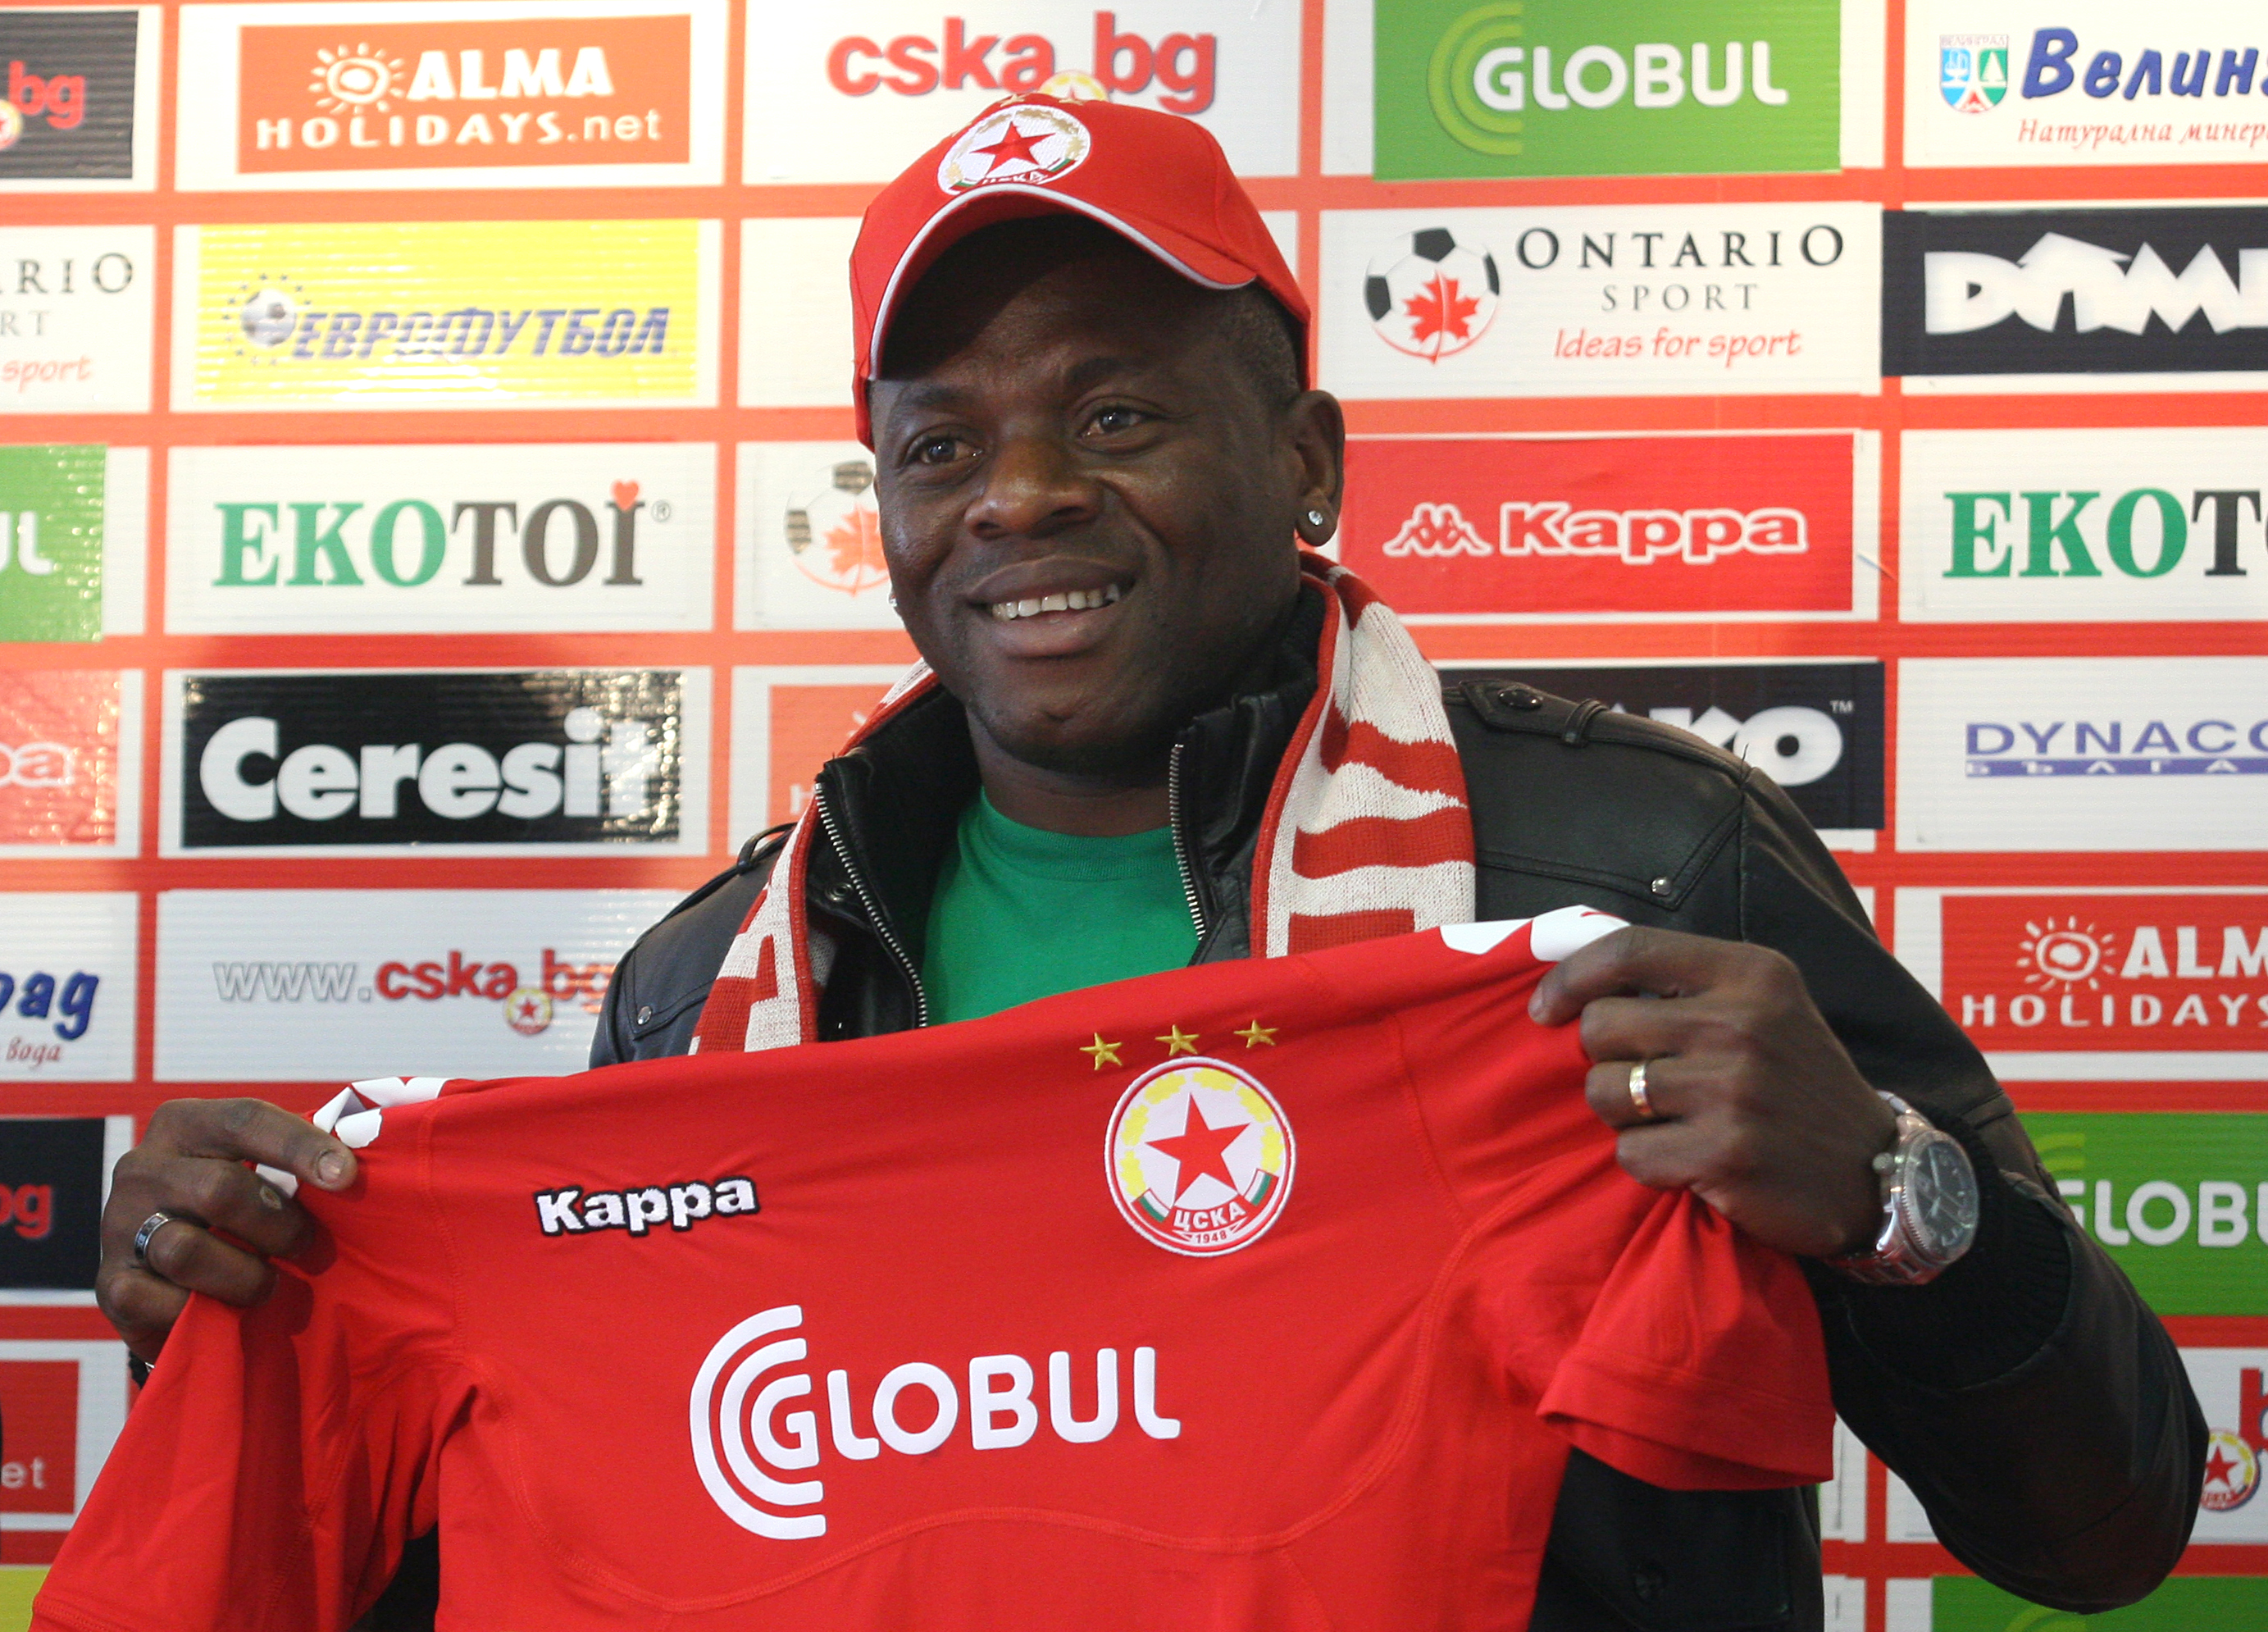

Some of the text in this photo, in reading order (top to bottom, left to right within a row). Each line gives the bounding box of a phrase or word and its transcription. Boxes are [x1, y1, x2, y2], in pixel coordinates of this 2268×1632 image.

[405, 47, 613, 101] ALMA
[1473, 41, 1788, 111] GLOBUL
[2020, 27, 2268, 100] Велин
[7, 61, 86, 130] bg
[255, 108, 661, 151] HOLIDAYS.net
[2018, 119, 2268, 149] Натурална минер
[1516, 225, 1844, 270] ONTARIO
[1601, 283, 1760, 312] SPORT
[291, 306, 670, 358] ЕВРОФУТБОЛ
[1554, 326, 1801, 369] Ideas for sport
[1, 355, 92, 394] sport
[212, 497, 645, 587] EKOTOI
[1499, 501, 1808, 564] Kappa
[1942, 489, 2268, 578] EKOT
[199, 706, 658, 822] Ceresit
[535, 1176, 759, 1237] Kappa
[1173, 1201, 1247, 1232] ЦСКА
[2059, 1179, 2268, 1247] LOB
[1195, 1230, 1227, 1244] 1948
[750, 1347, 1182, 1470] GLOBUL
